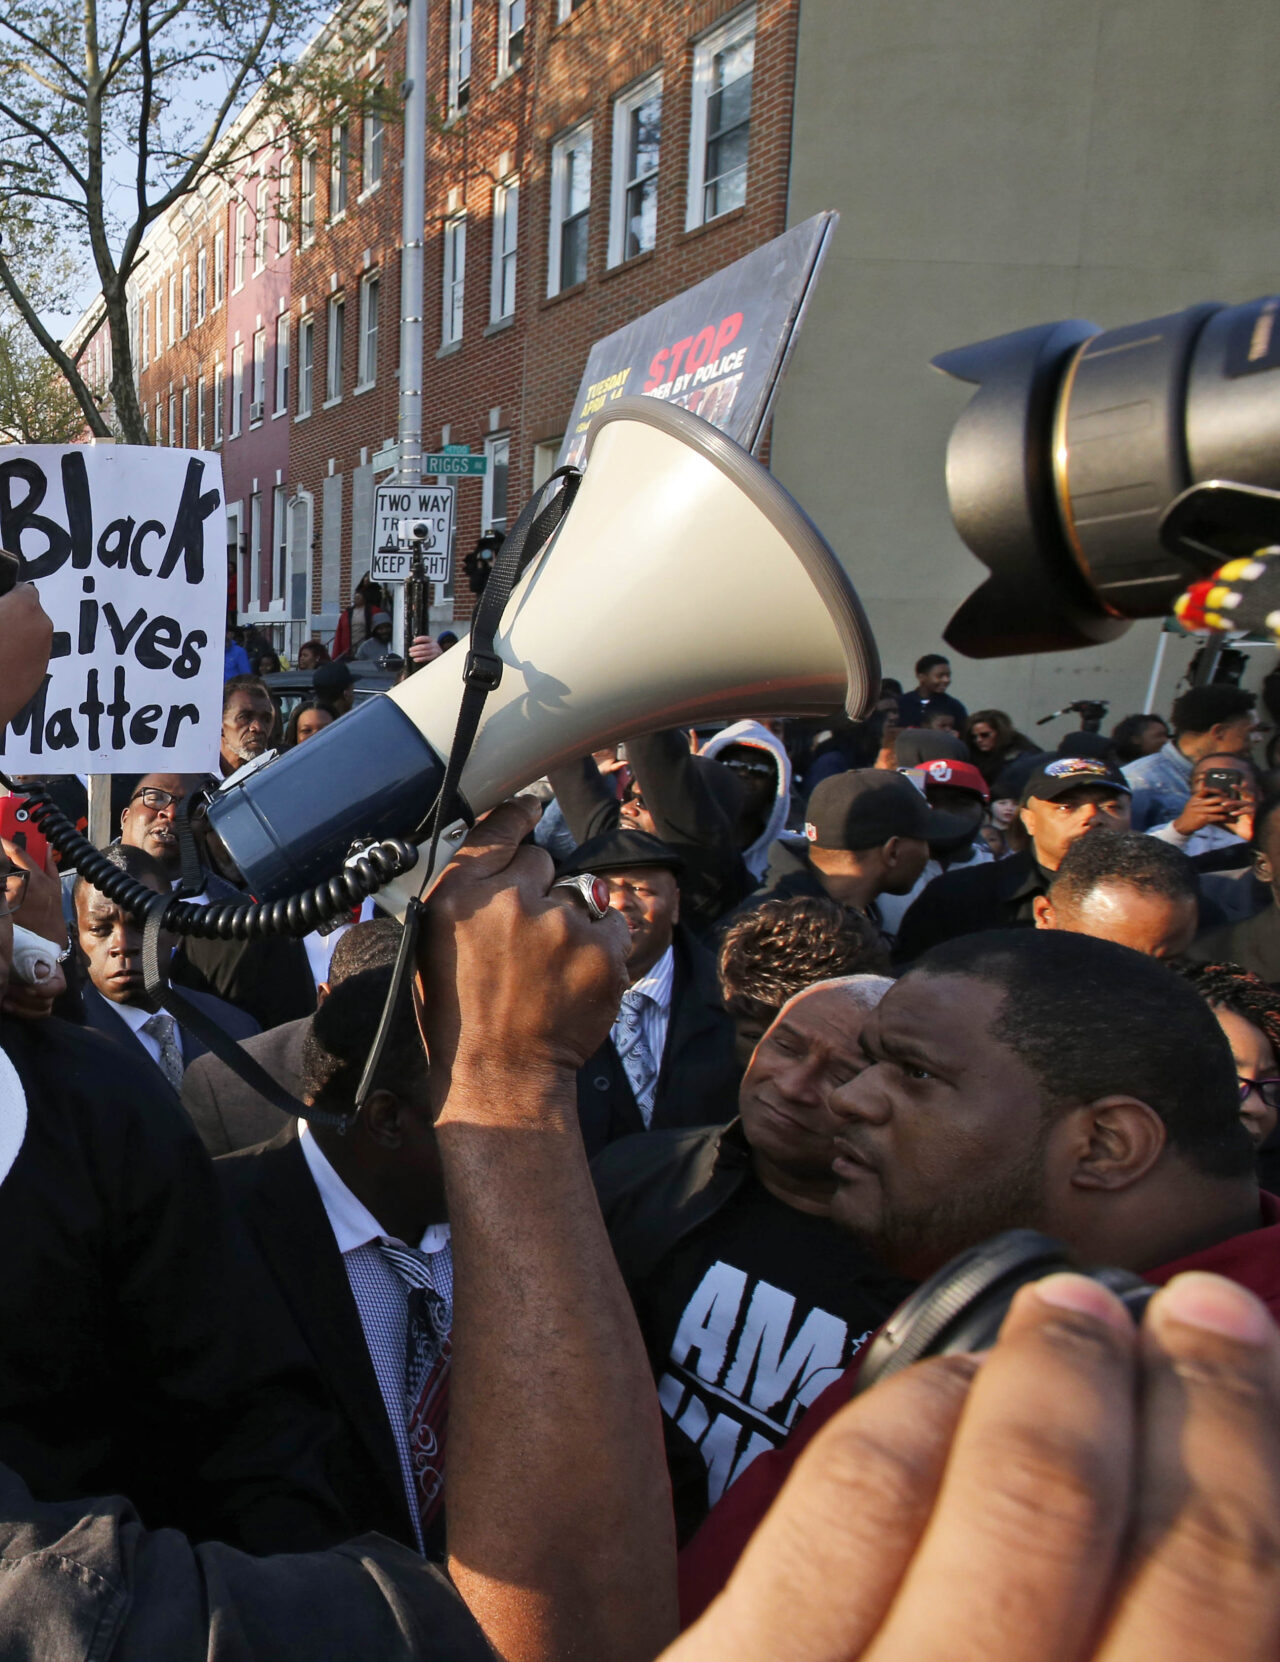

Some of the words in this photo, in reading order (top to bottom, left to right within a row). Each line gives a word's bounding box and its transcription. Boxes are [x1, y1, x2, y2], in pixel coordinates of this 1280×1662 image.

[643, 312, 744, 393] STOP
[587, 367, 632, 401] TUESDAY
[671, 373, 693, 396] BY
[692, 347, 749, 387] POLICE
[429, 458, 469, 472] RIGGS
[379, 494, 411, 512] TWO
[418, 496, 451, 513] WAY
[382, 517, 445, 532] TRIC
[373, 556, 406, 573] KEEP
[409, 556, 447, 574] GHT
[28, 576, 208, 679] ives
